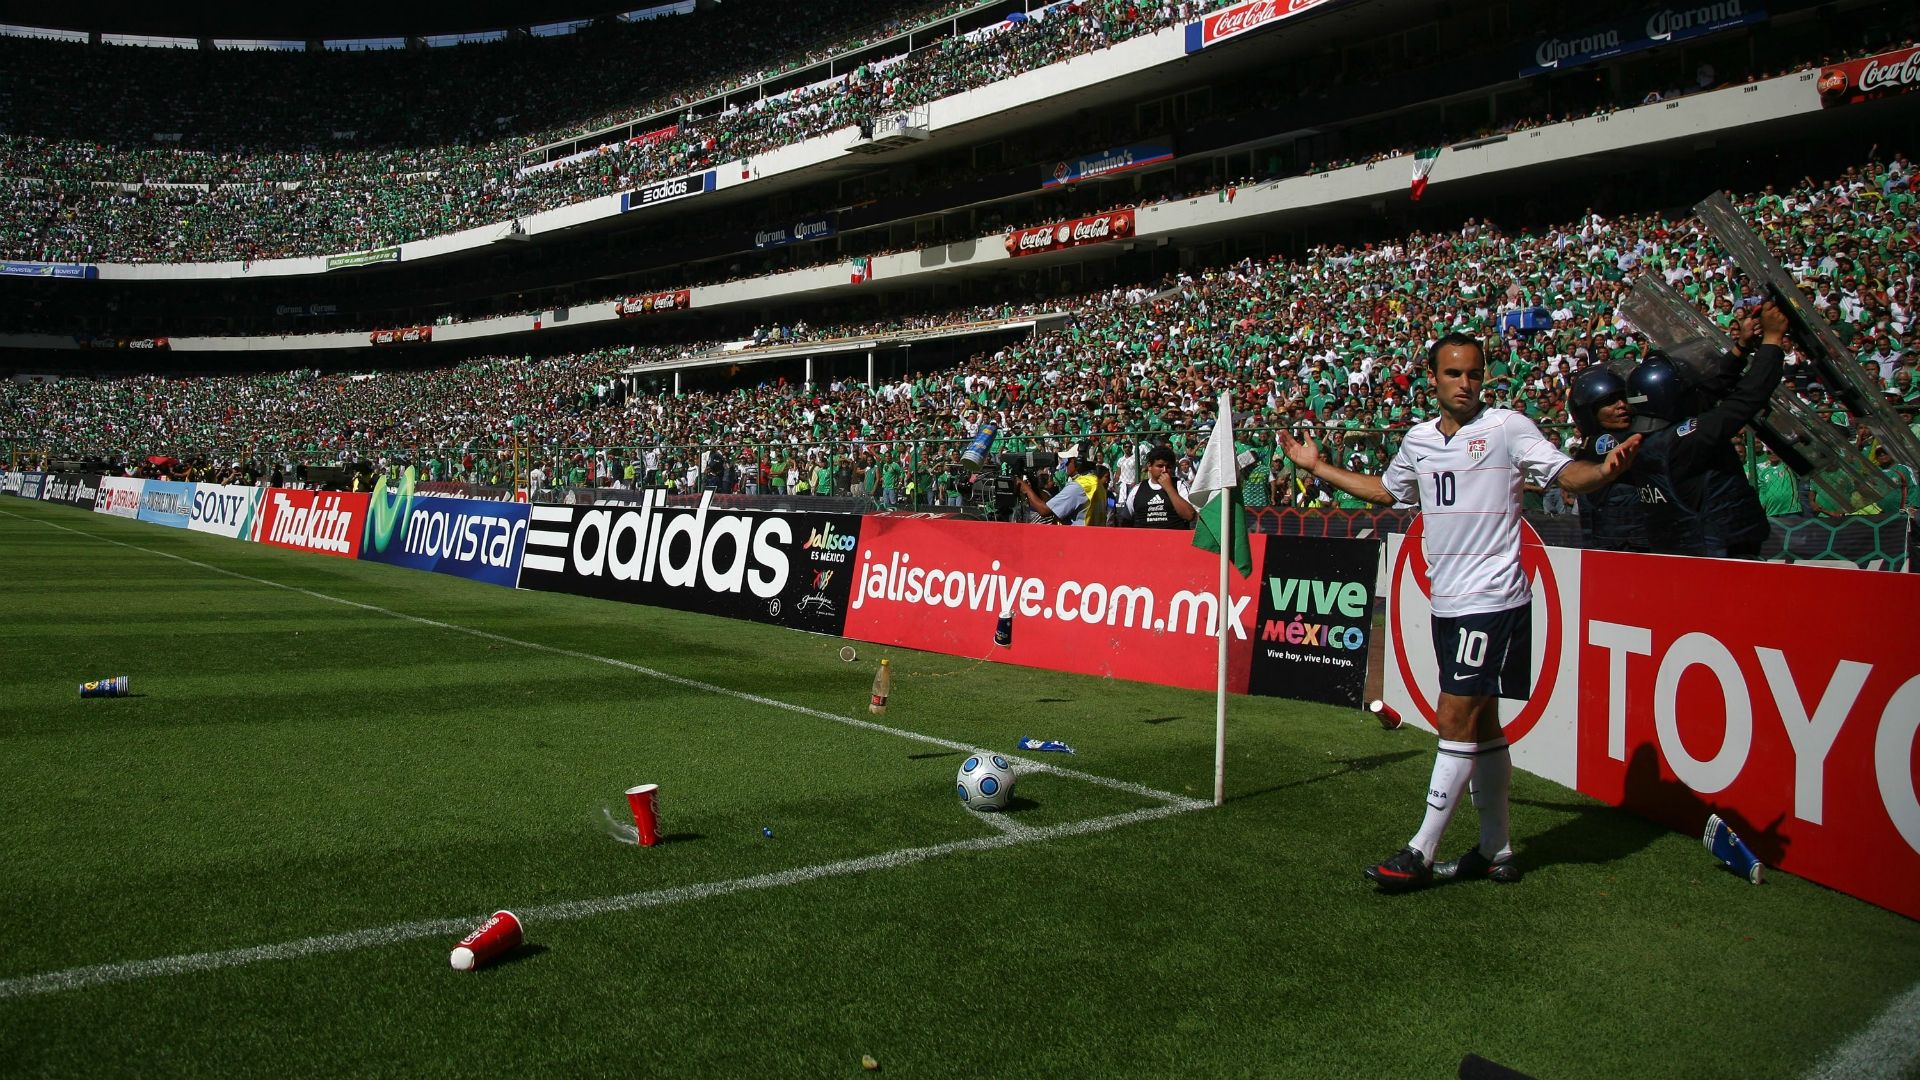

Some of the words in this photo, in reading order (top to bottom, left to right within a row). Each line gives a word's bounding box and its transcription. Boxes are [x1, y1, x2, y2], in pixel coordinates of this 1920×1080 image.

[1213, 0, 1276, 38] Coca-Cola
[1646, 0, 1742, 41] Corona
[1536, 29, 1620, 68] Corona
[1859, 50, 1920, 91] Coca-C
[1080, 150, 1133, 176] Domino's
[653, 180, 687, 200] adidas
[755, 230, 785, 247] Corona
[794, 221, 827, 240] Corona
[1020, 227, 1054, 250] Coca-Cola
[1074, 217, 1110, 240] Coca-Cola
[654, 294, 675, 309] Coca-Cola
[1433, 471, 1456, 506] 10
[191, 490, 244, 526] SONY
[405, 509, 526, 568] movistar
[573, 488, 792, 598] adidas
[803, 521, 855, 551] Jalisco
[811, 551, 820, 560] ES
[821, 551, 845, 563] MÉXICO
[852, 549, 1252, 640] jaliscovive.com.mx
[1267, 649, 1284, 659] Vive
[1285, 651, 1302, 662] hoy,
[1304, 653, 1321, 663] vive
[1322, 655, 1331, 664] lo
[1332, 657, 1354, 668] tuyo.
[1456, 627, 1489, 667] 10
[1428, 789, 1448, 799] USA
